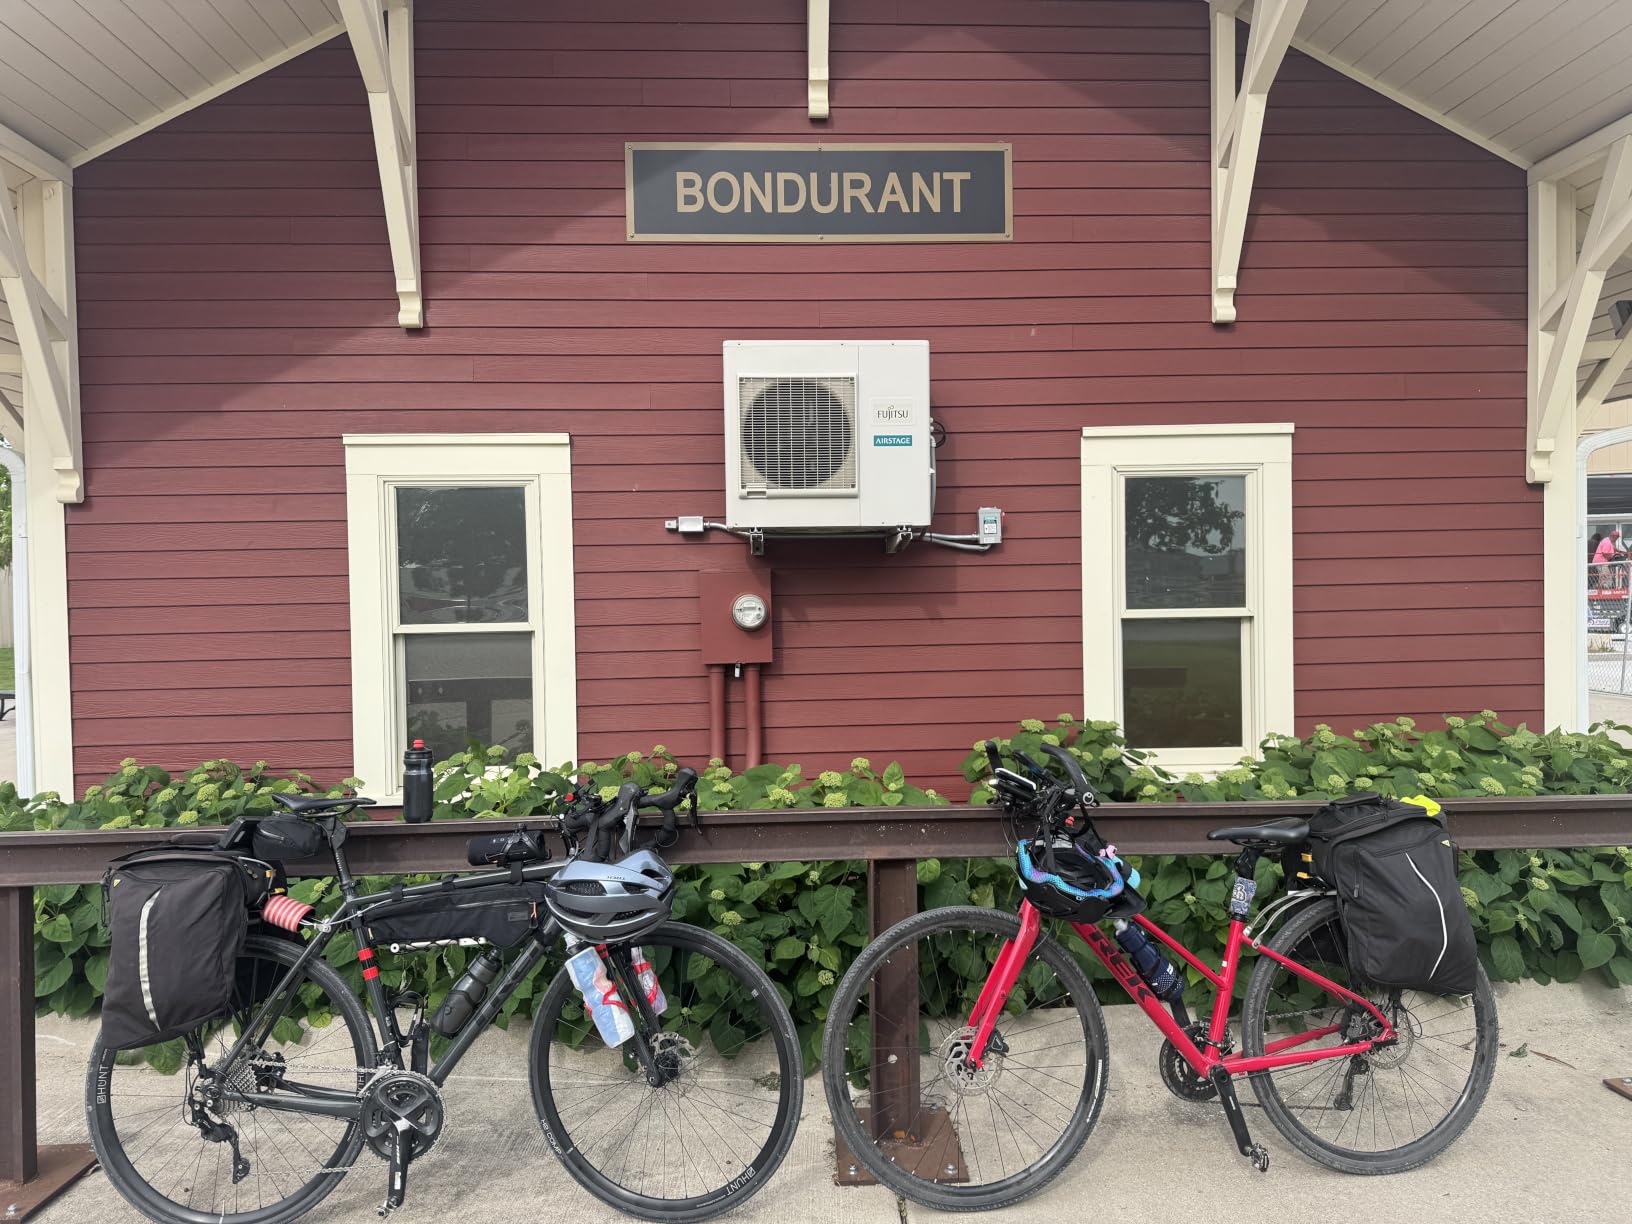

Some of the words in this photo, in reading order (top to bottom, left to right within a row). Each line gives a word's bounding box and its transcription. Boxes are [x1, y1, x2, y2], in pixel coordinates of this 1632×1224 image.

[675, 171, 971, 214] BONDURANT
[877, 405, 909, 420] FUJITSU
[875, 436, 911, 445] AIRSTAGE
[1089, 926, 1156, 1003] REK
[97, 1064, 108, 1094] HUNT
[547, 1132, 562, 1154] COMP
[726, 1173, 750, 1196] HUNT
